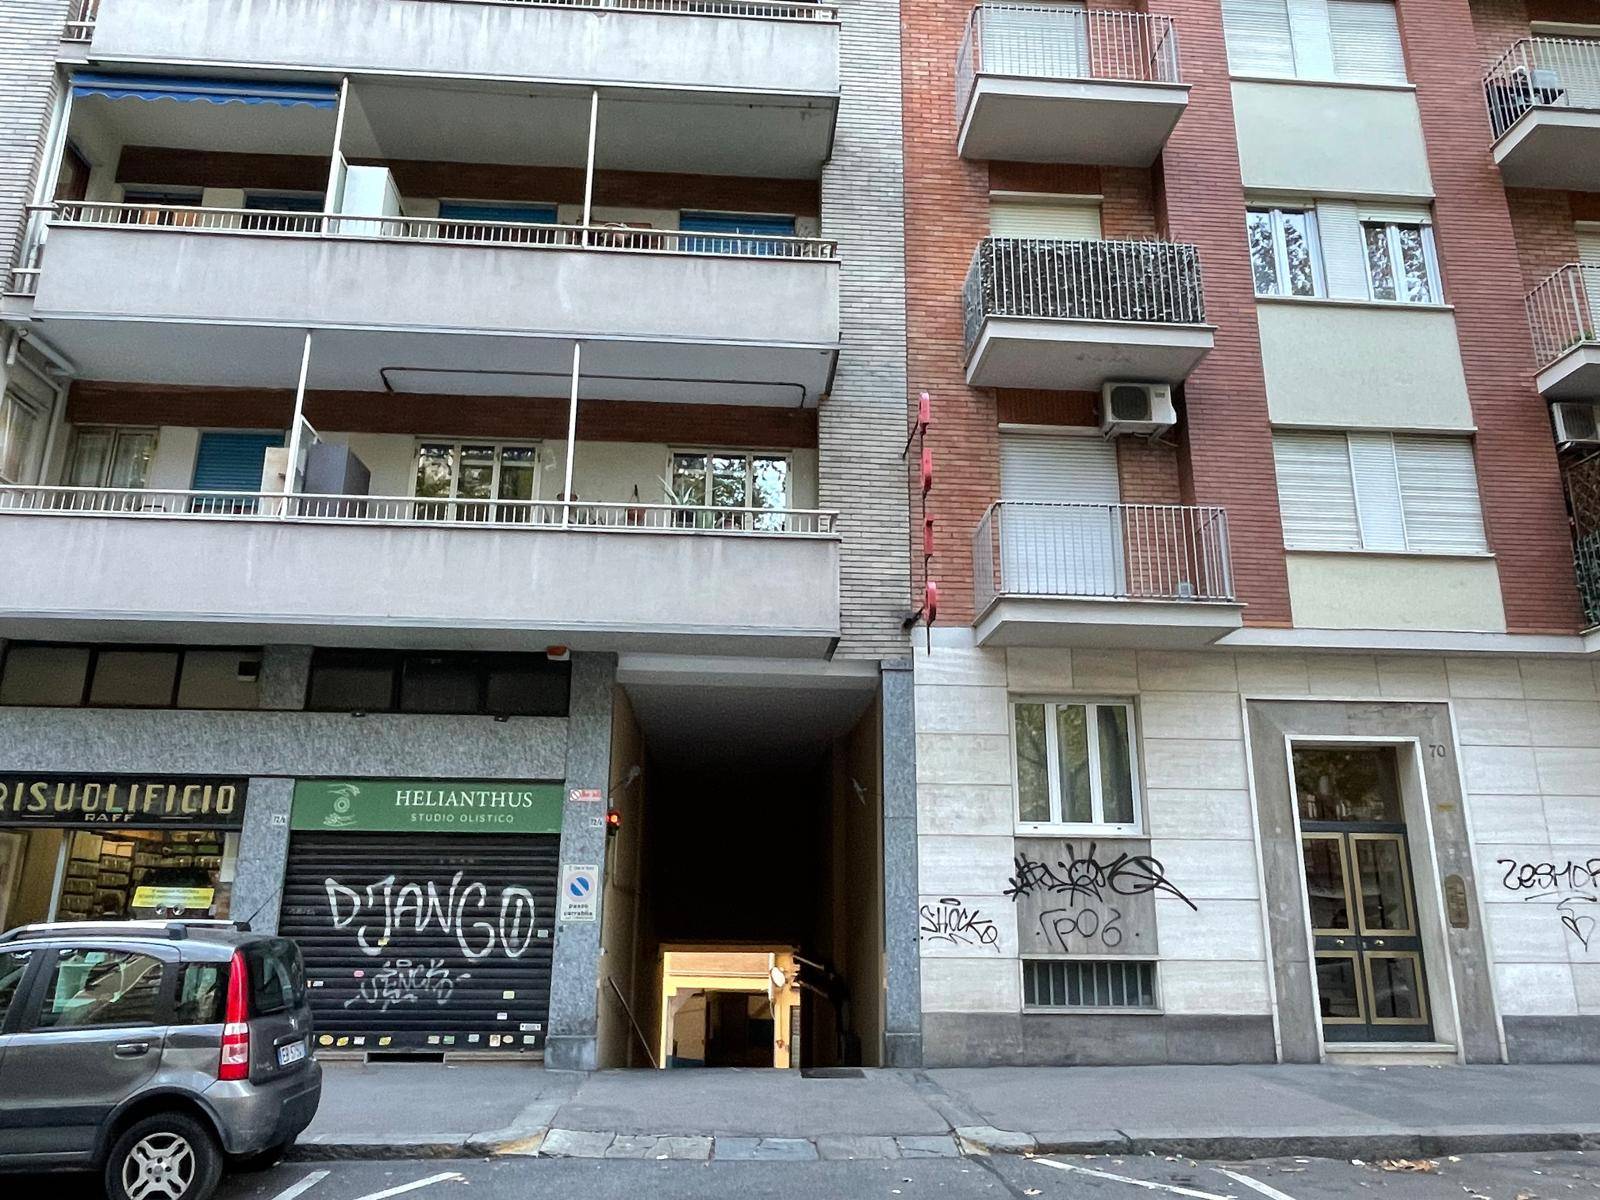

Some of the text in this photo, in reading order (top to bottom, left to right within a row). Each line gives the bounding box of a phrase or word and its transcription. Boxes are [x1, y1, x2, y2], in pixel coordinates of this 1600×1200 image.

[1429, 744, 1446, 758] 70
[395, 790, 533, 808] HELIANTHUS
[84, 813, 136, 823] RAFF
[410, 813, 515, 824] STUDIO OLISTICO
